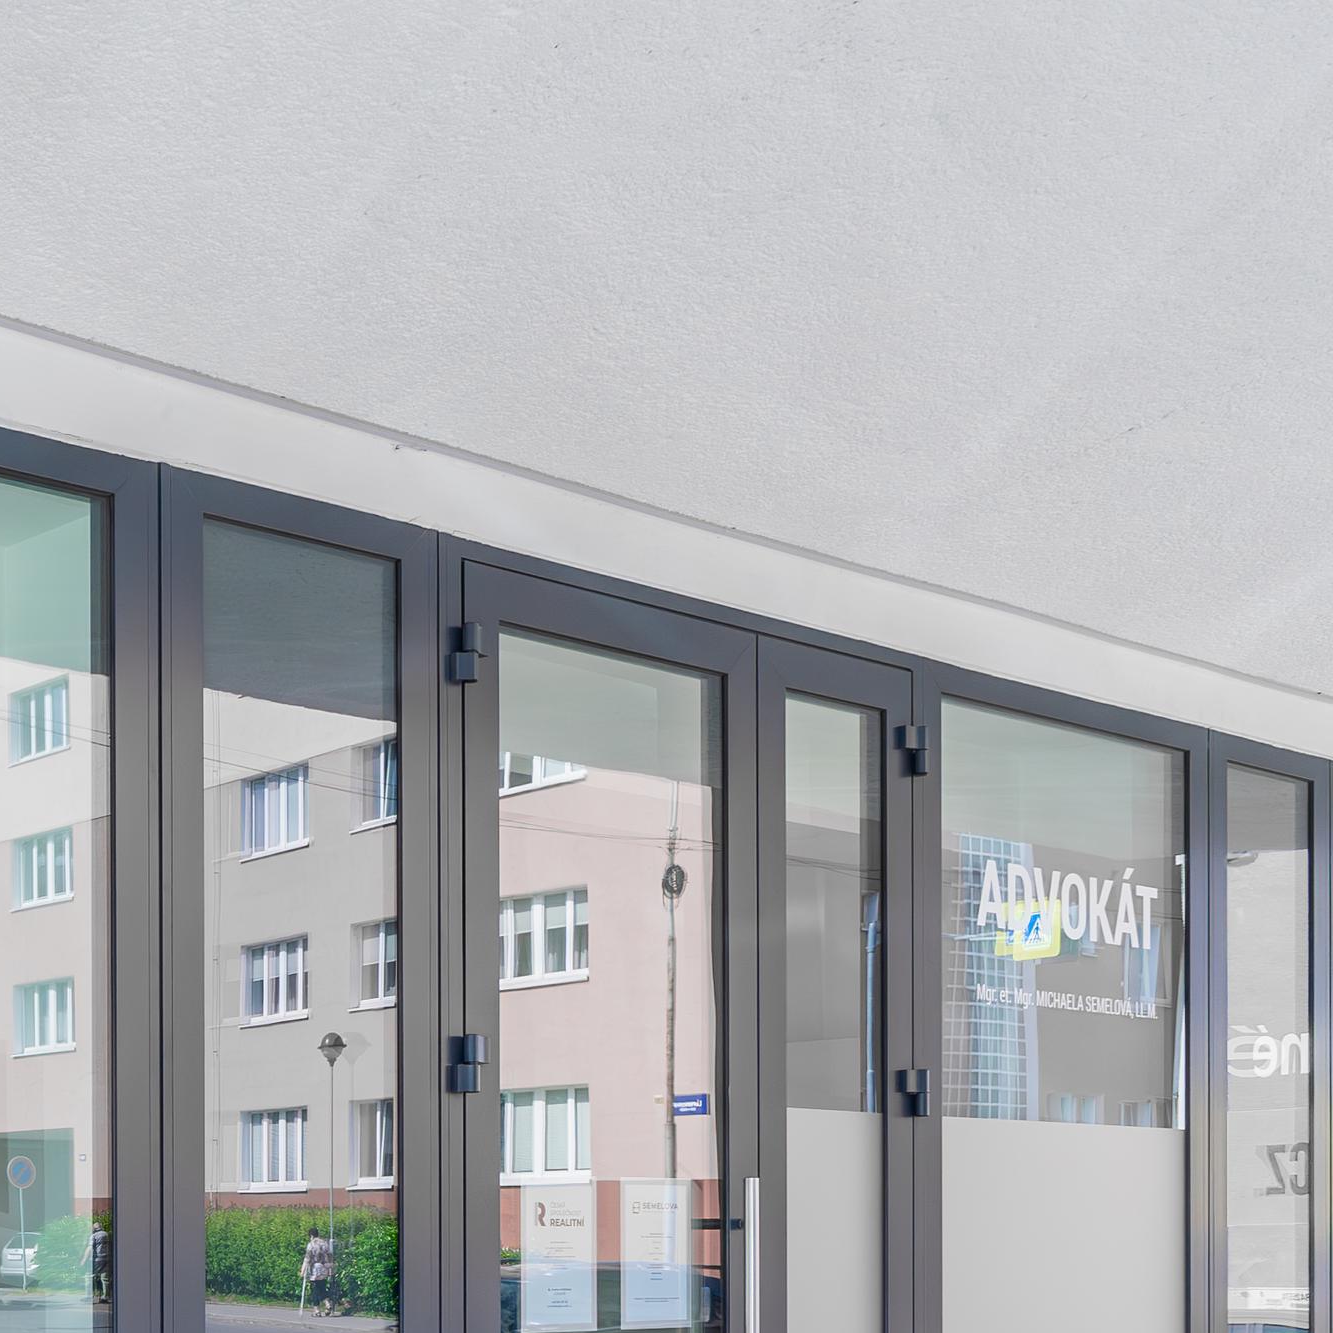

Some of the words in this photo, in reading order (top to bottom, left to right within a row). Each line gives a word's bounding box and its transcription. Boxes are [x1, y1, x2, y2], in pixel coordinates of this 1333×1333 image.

[977, 860, 1158, 949] ADVOKÁT
[977, 984, 997, 1005] Mgr.
[1015, 989, 1034, 1009] Mgr.
[1037, 991, 1084, 1011] MICHAELA
[1086, 996, 1134, 1019] SEMELOVÁ,
[550, 1216, 584, 1227] REALITNÍ
